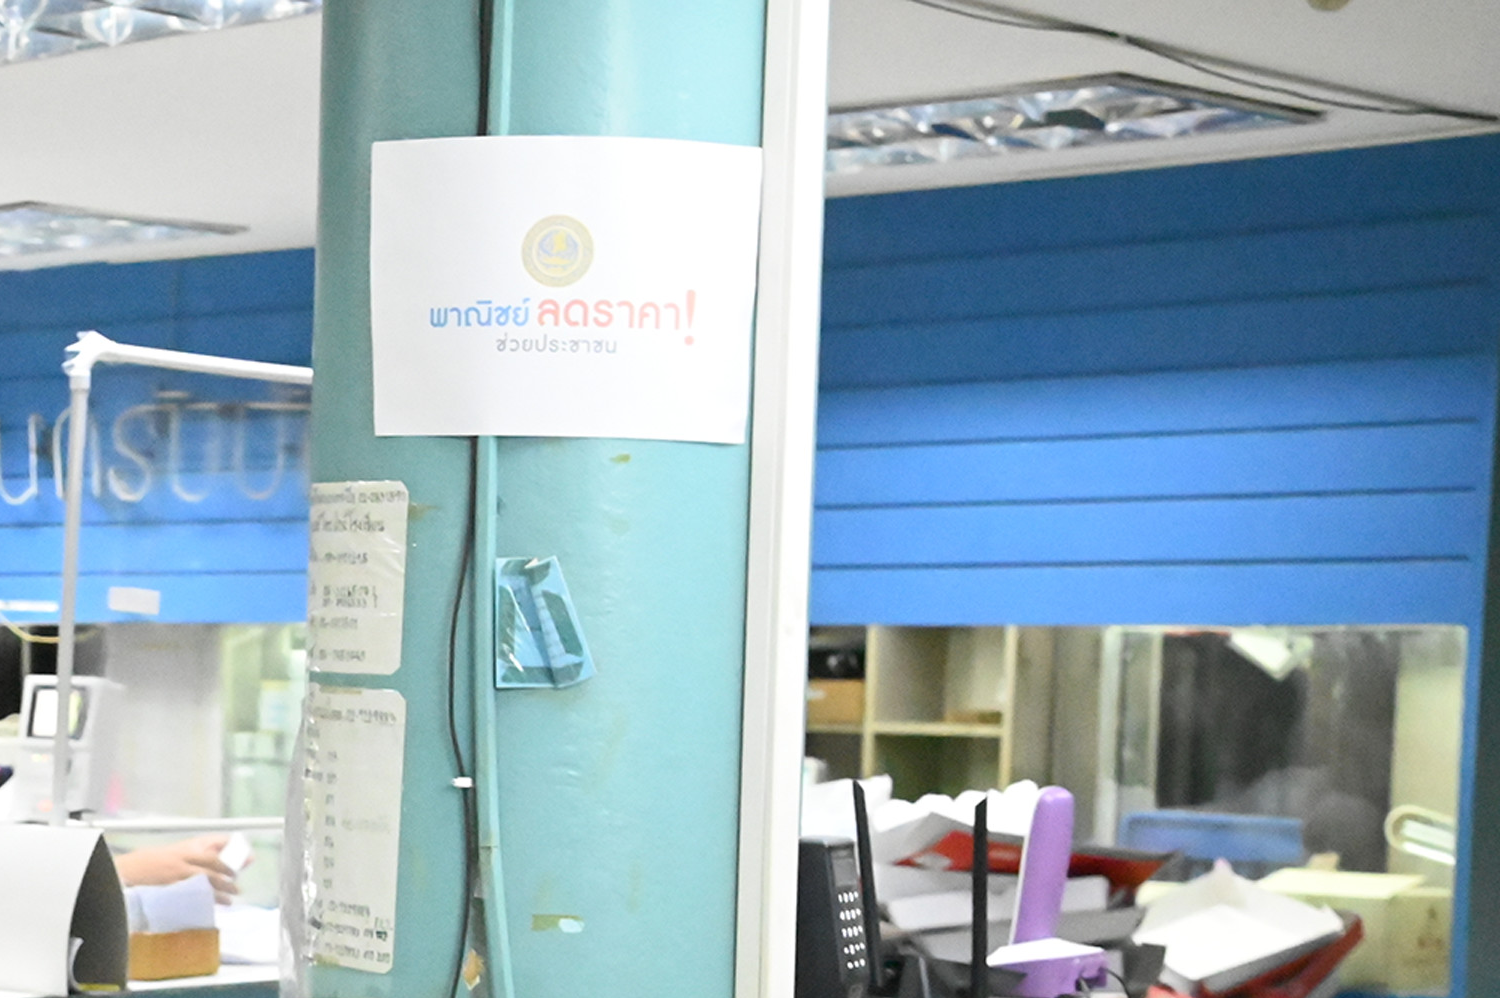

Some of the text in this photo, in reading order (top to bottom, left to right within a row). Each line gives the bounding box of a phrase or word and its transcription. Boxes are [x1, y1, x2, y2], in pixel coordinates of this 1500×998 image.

[429, 289, 696, 346] พาณิชย์ ลดราคา!
[495, 332, 617, 354] ช่วยประชาชน
